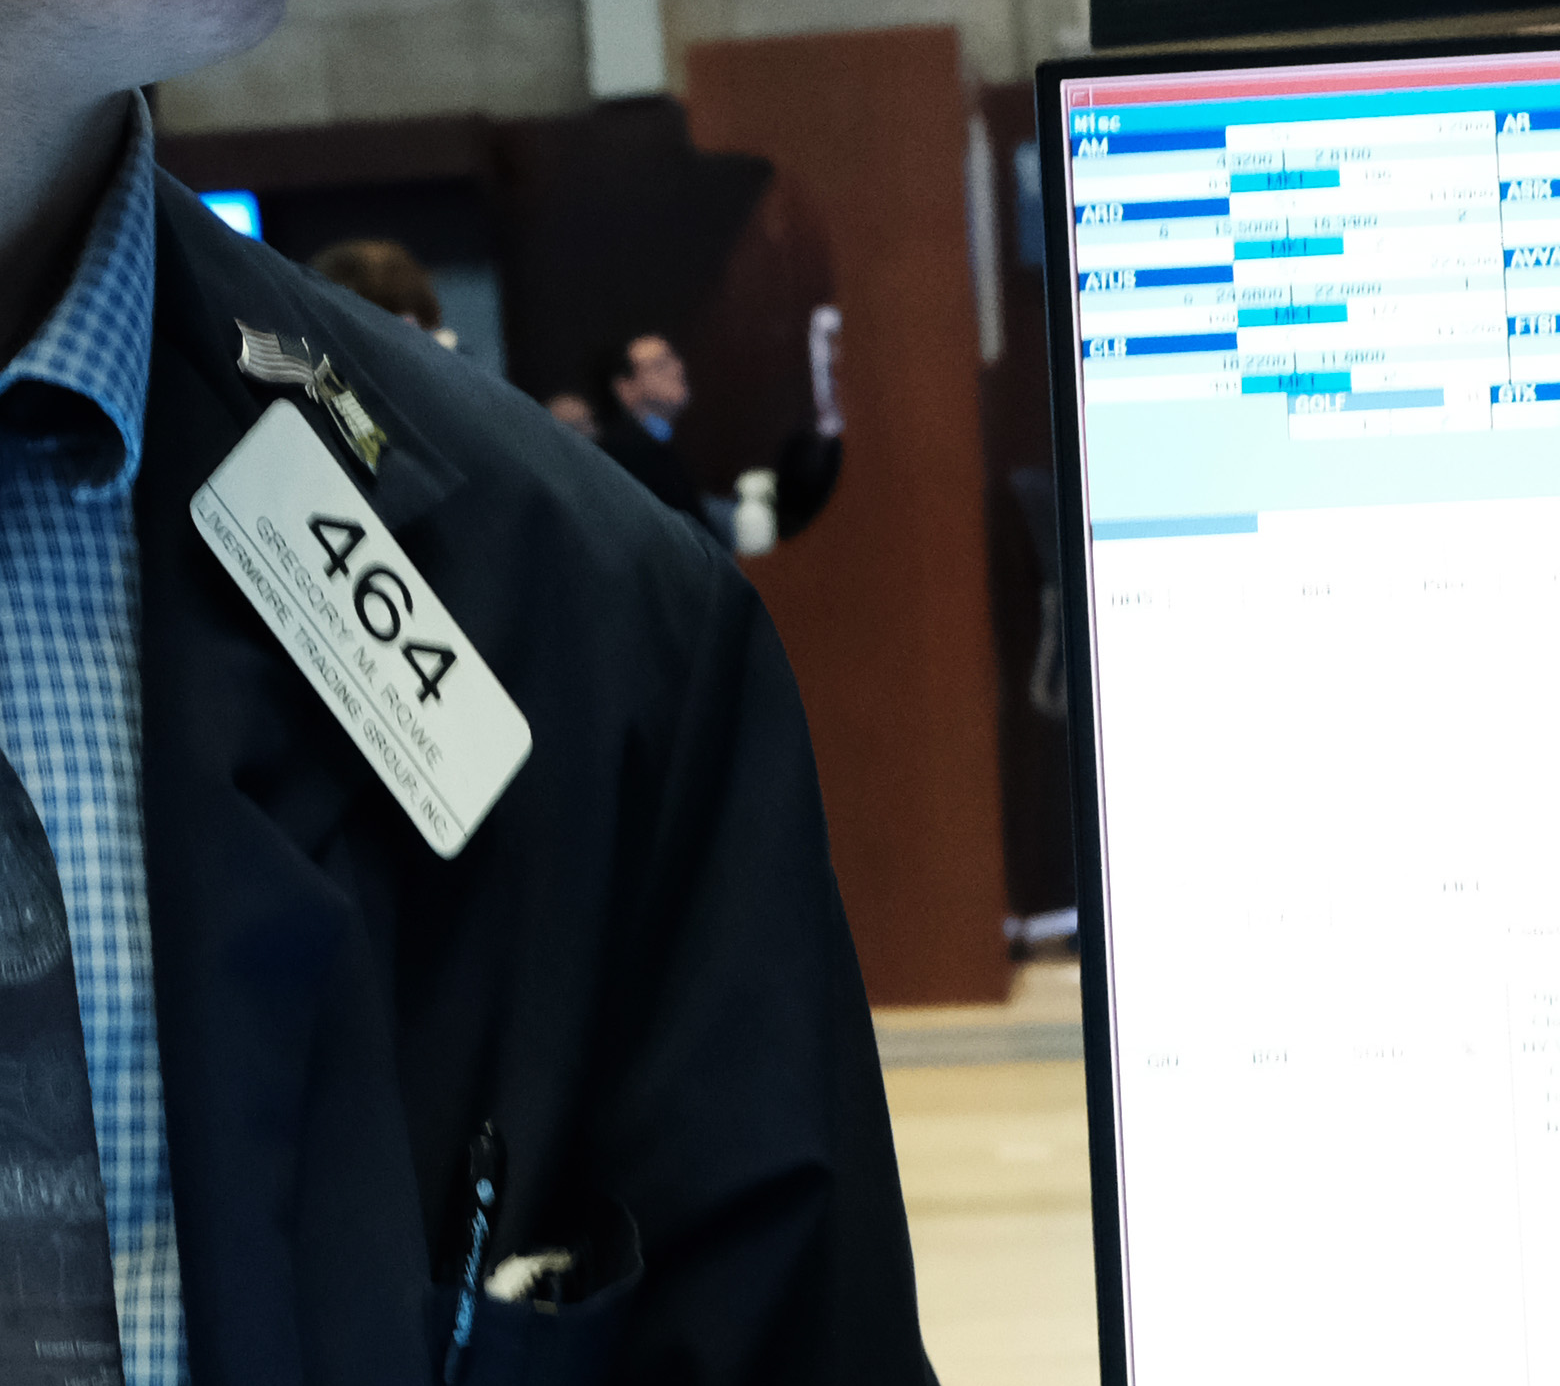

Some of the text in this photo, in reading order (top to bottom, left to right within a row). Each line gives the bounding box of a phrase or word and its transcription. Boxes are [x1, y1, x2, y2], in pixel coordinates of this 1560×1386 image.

[195, 495, 294, 629] LIVERMORE
[293, 622, 364, 719] TRADING
[255, 515, 355, 647] GREGORY
[380, 681, 445, 772] ROWE
[305, 512, 459, 709] 464
